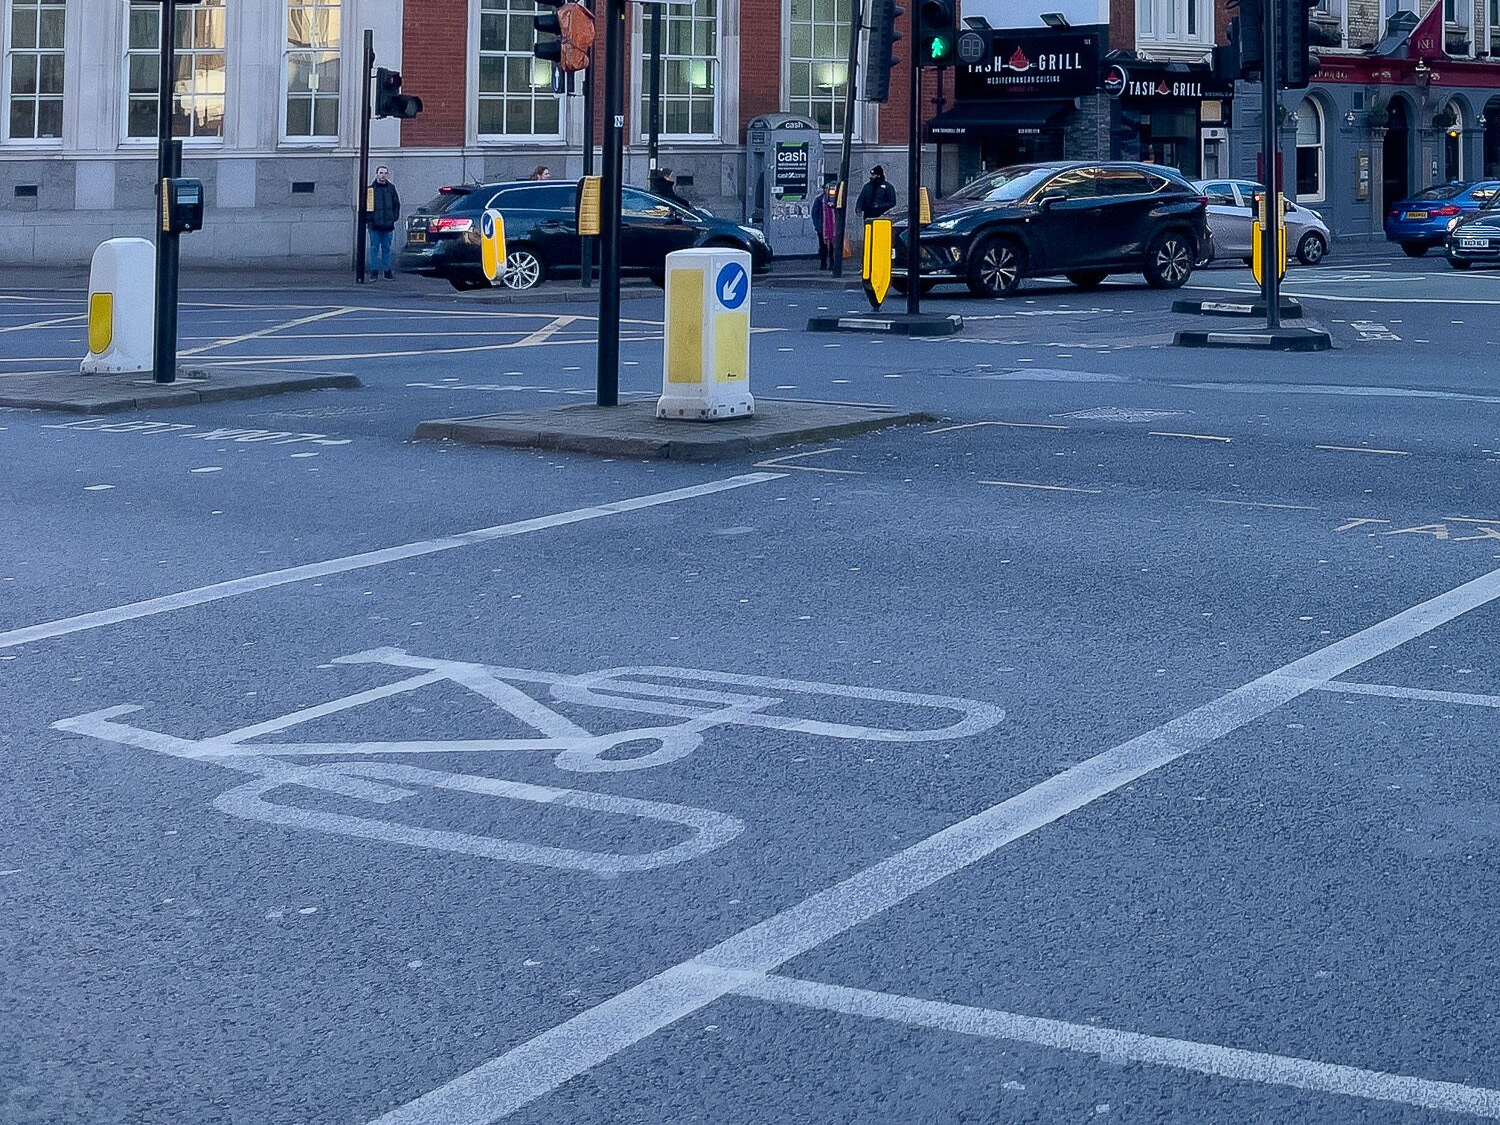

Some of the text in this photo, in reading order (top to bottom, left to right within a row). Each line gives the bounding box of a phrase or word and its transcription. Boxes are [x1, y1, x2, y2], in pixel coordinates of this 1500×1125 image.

[1038, 52, 1082, 71] GRILL
[1036, 75, 1060, 83] CUISINE
[1129, 81, 1203, 97] TASH GRILL
[785, 121, 804, 129] cash
[777, 149, 807, 162] cash
